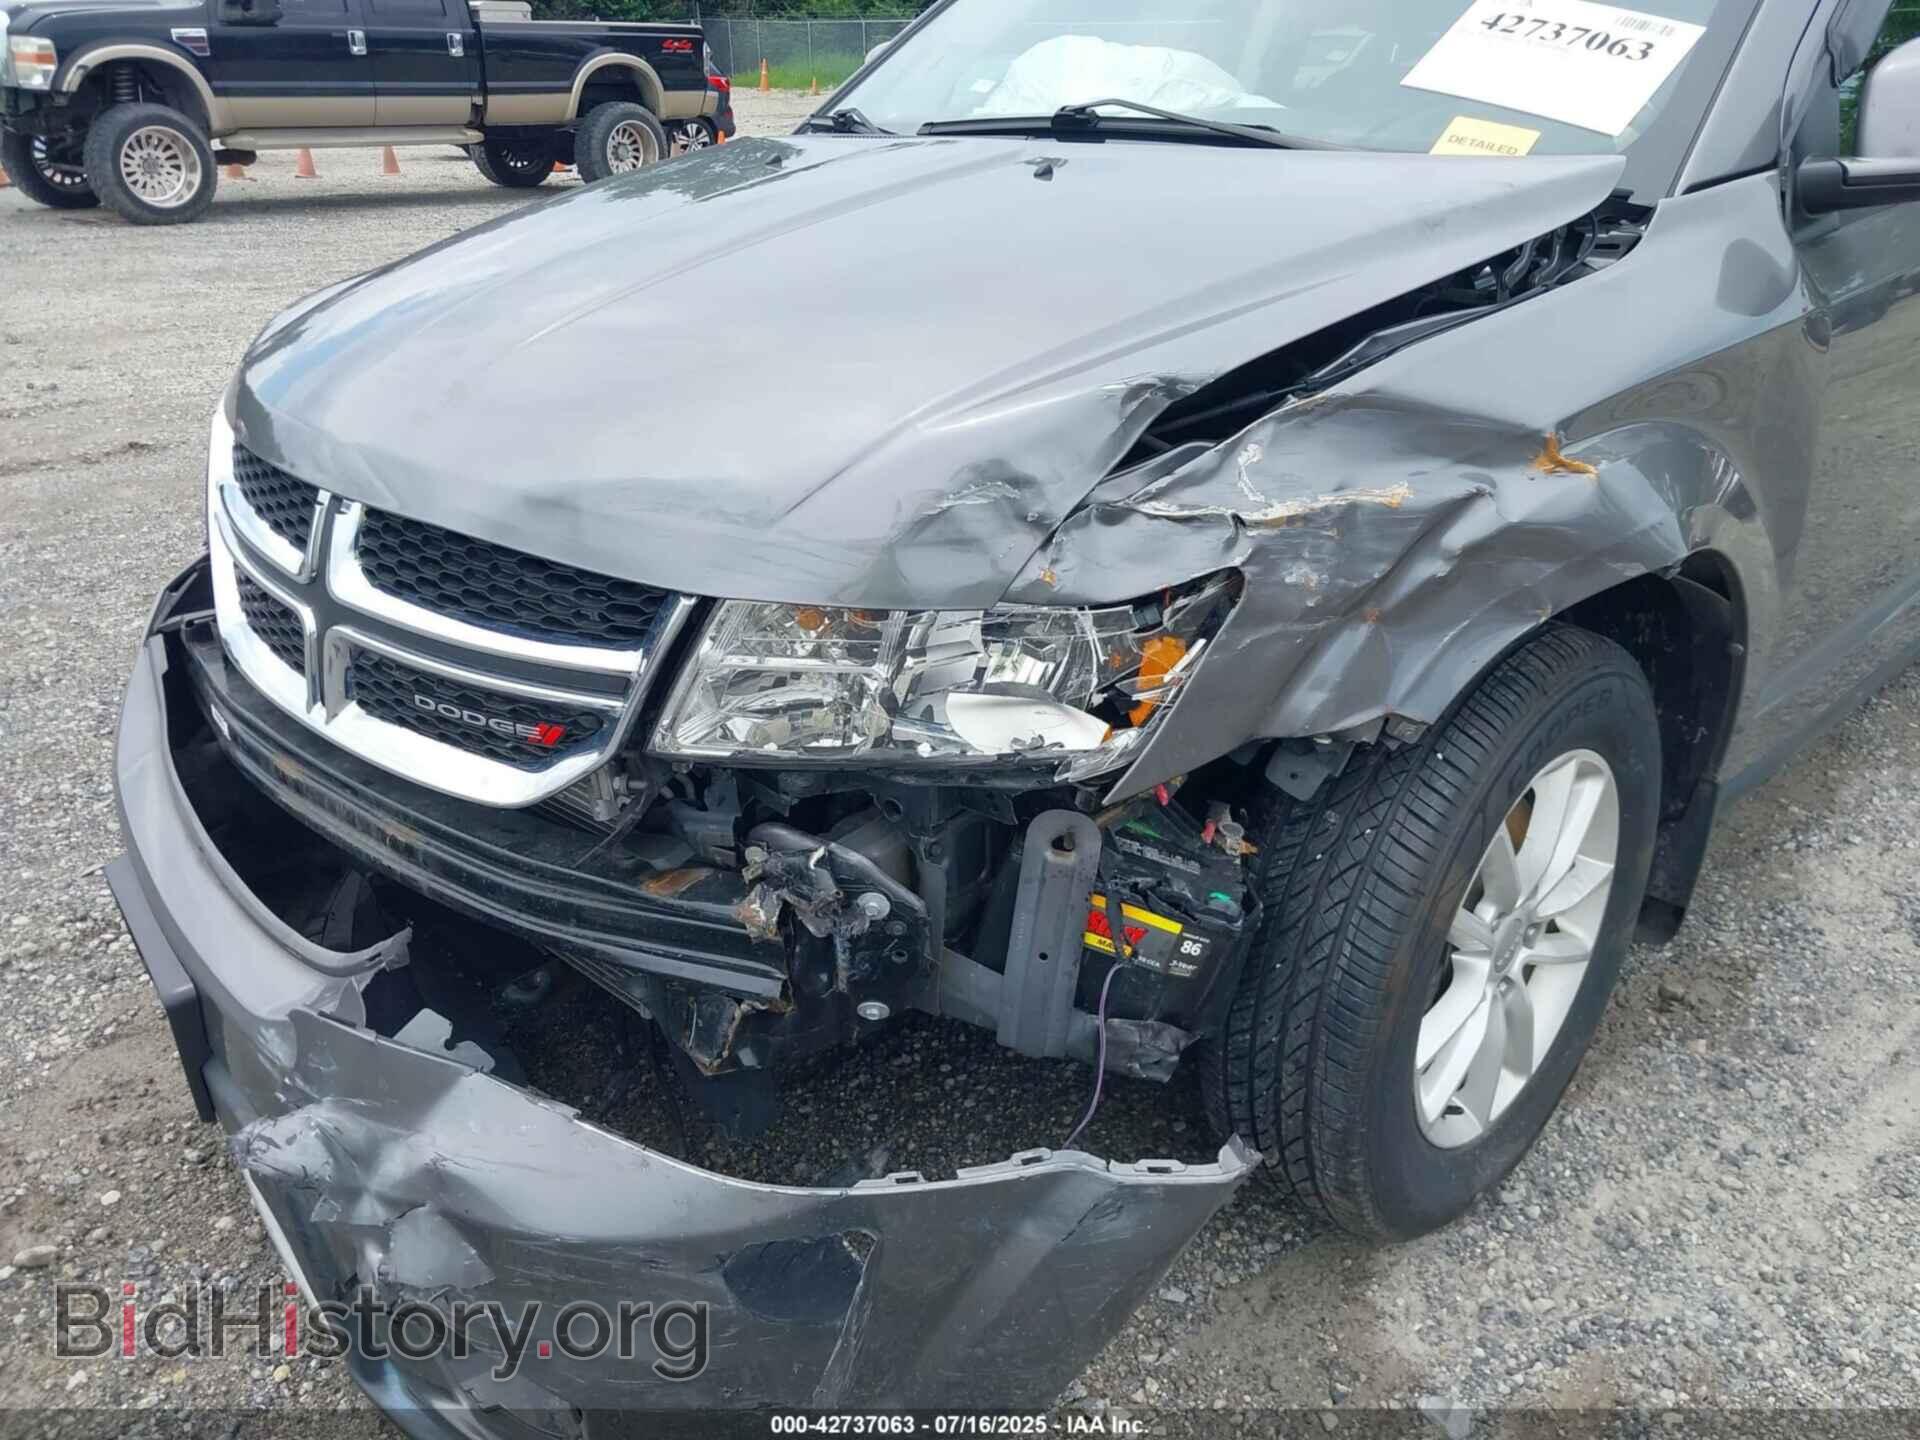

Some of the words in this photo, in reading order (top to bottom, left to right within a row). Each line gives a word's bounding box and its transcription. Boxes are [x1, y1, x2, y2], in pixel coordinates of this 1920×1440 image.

[1480, 12, 1655, 61] 42737063
[1447, 134, 1519, 155] DETAILED
[414, 694, 543, 740] DODGE
[1180, 940, 1203, 956] 86
